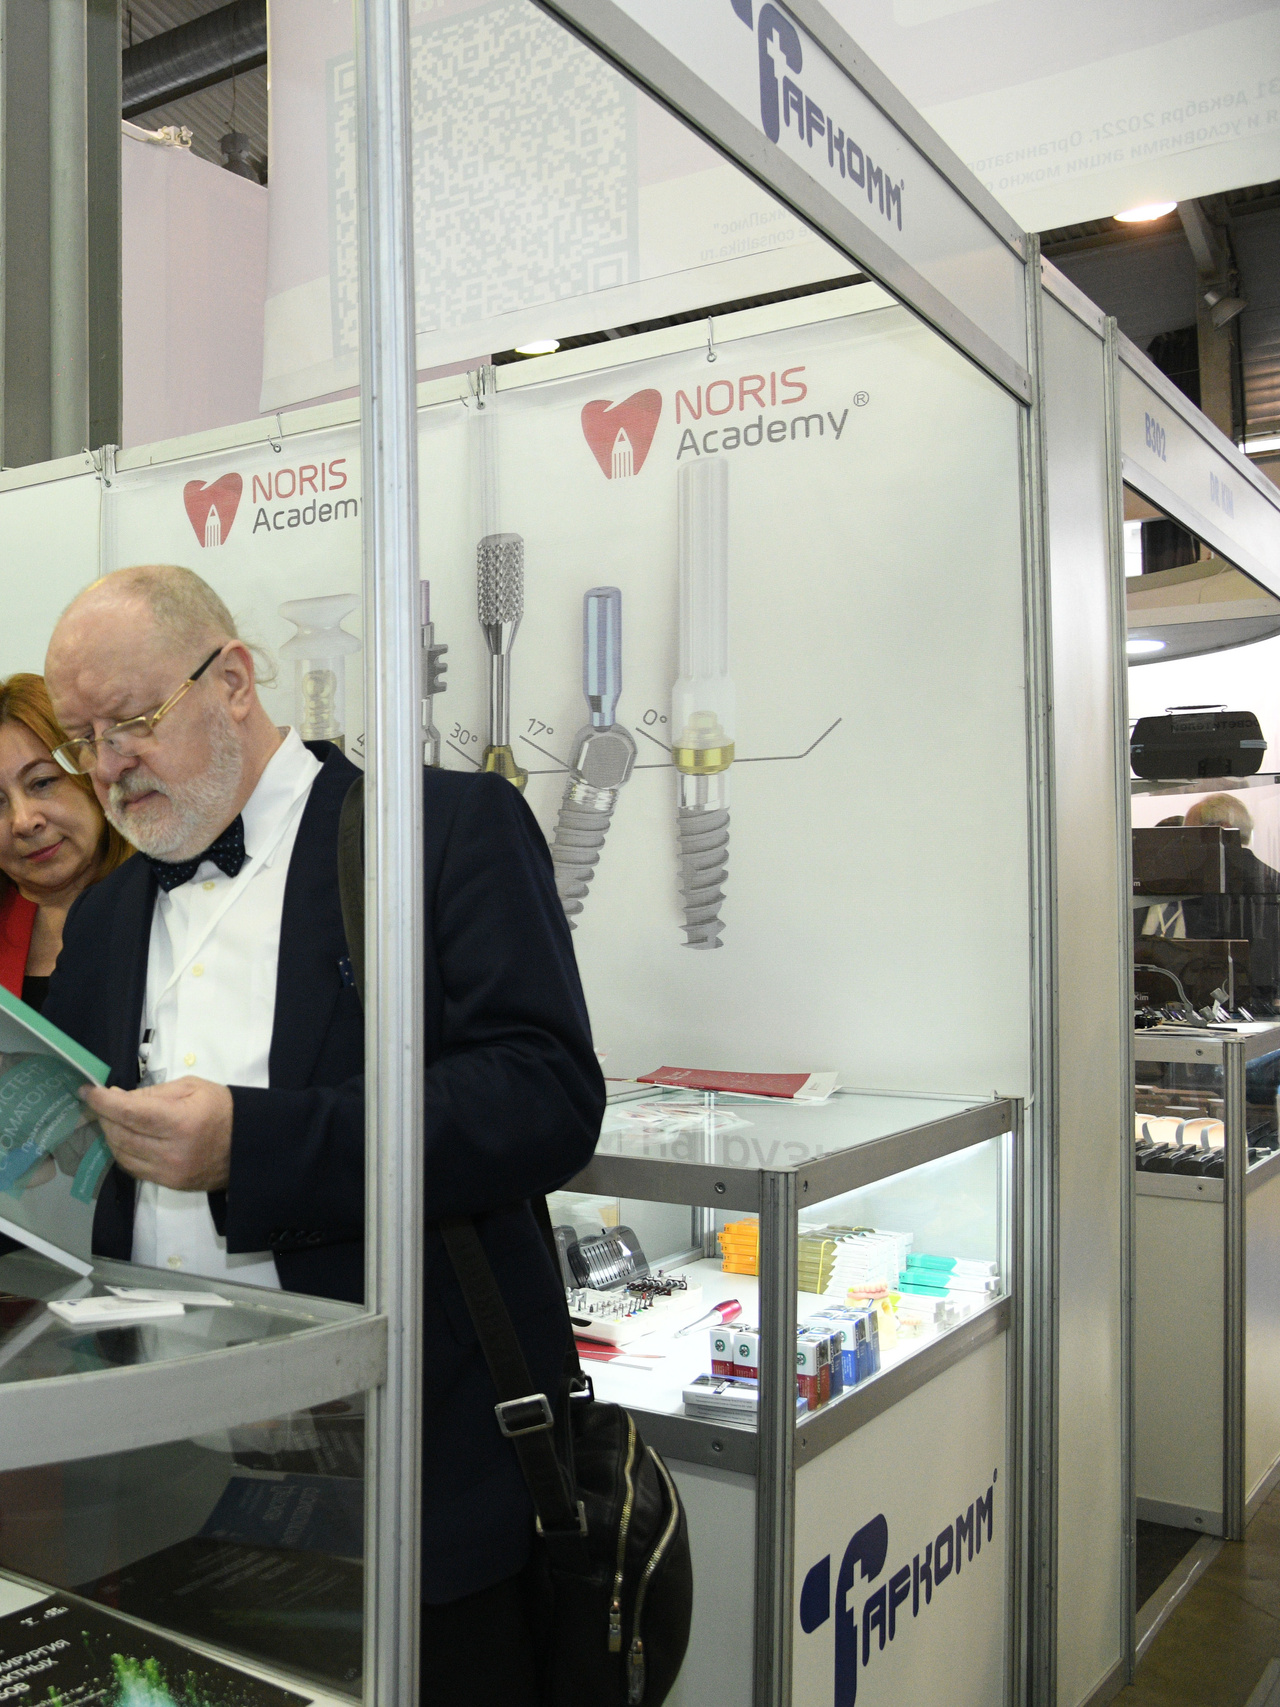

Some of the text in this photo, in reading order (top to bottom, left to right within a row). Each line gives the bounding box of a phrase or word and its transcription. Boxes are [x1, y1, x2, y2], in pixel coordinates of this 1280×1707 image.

[676, 365, 806, 425] NORIS
[677, 407, 849, 460] Academy
[1144, 411, 1167, 463] B302
[252, 459, 348, 504] NORIS
[253, 498, 362, 535] Academ
[449, 721, 478, 748] 30°
[526, 717, 554, 738] 17°
[641, 708, 668, 728] 0°
